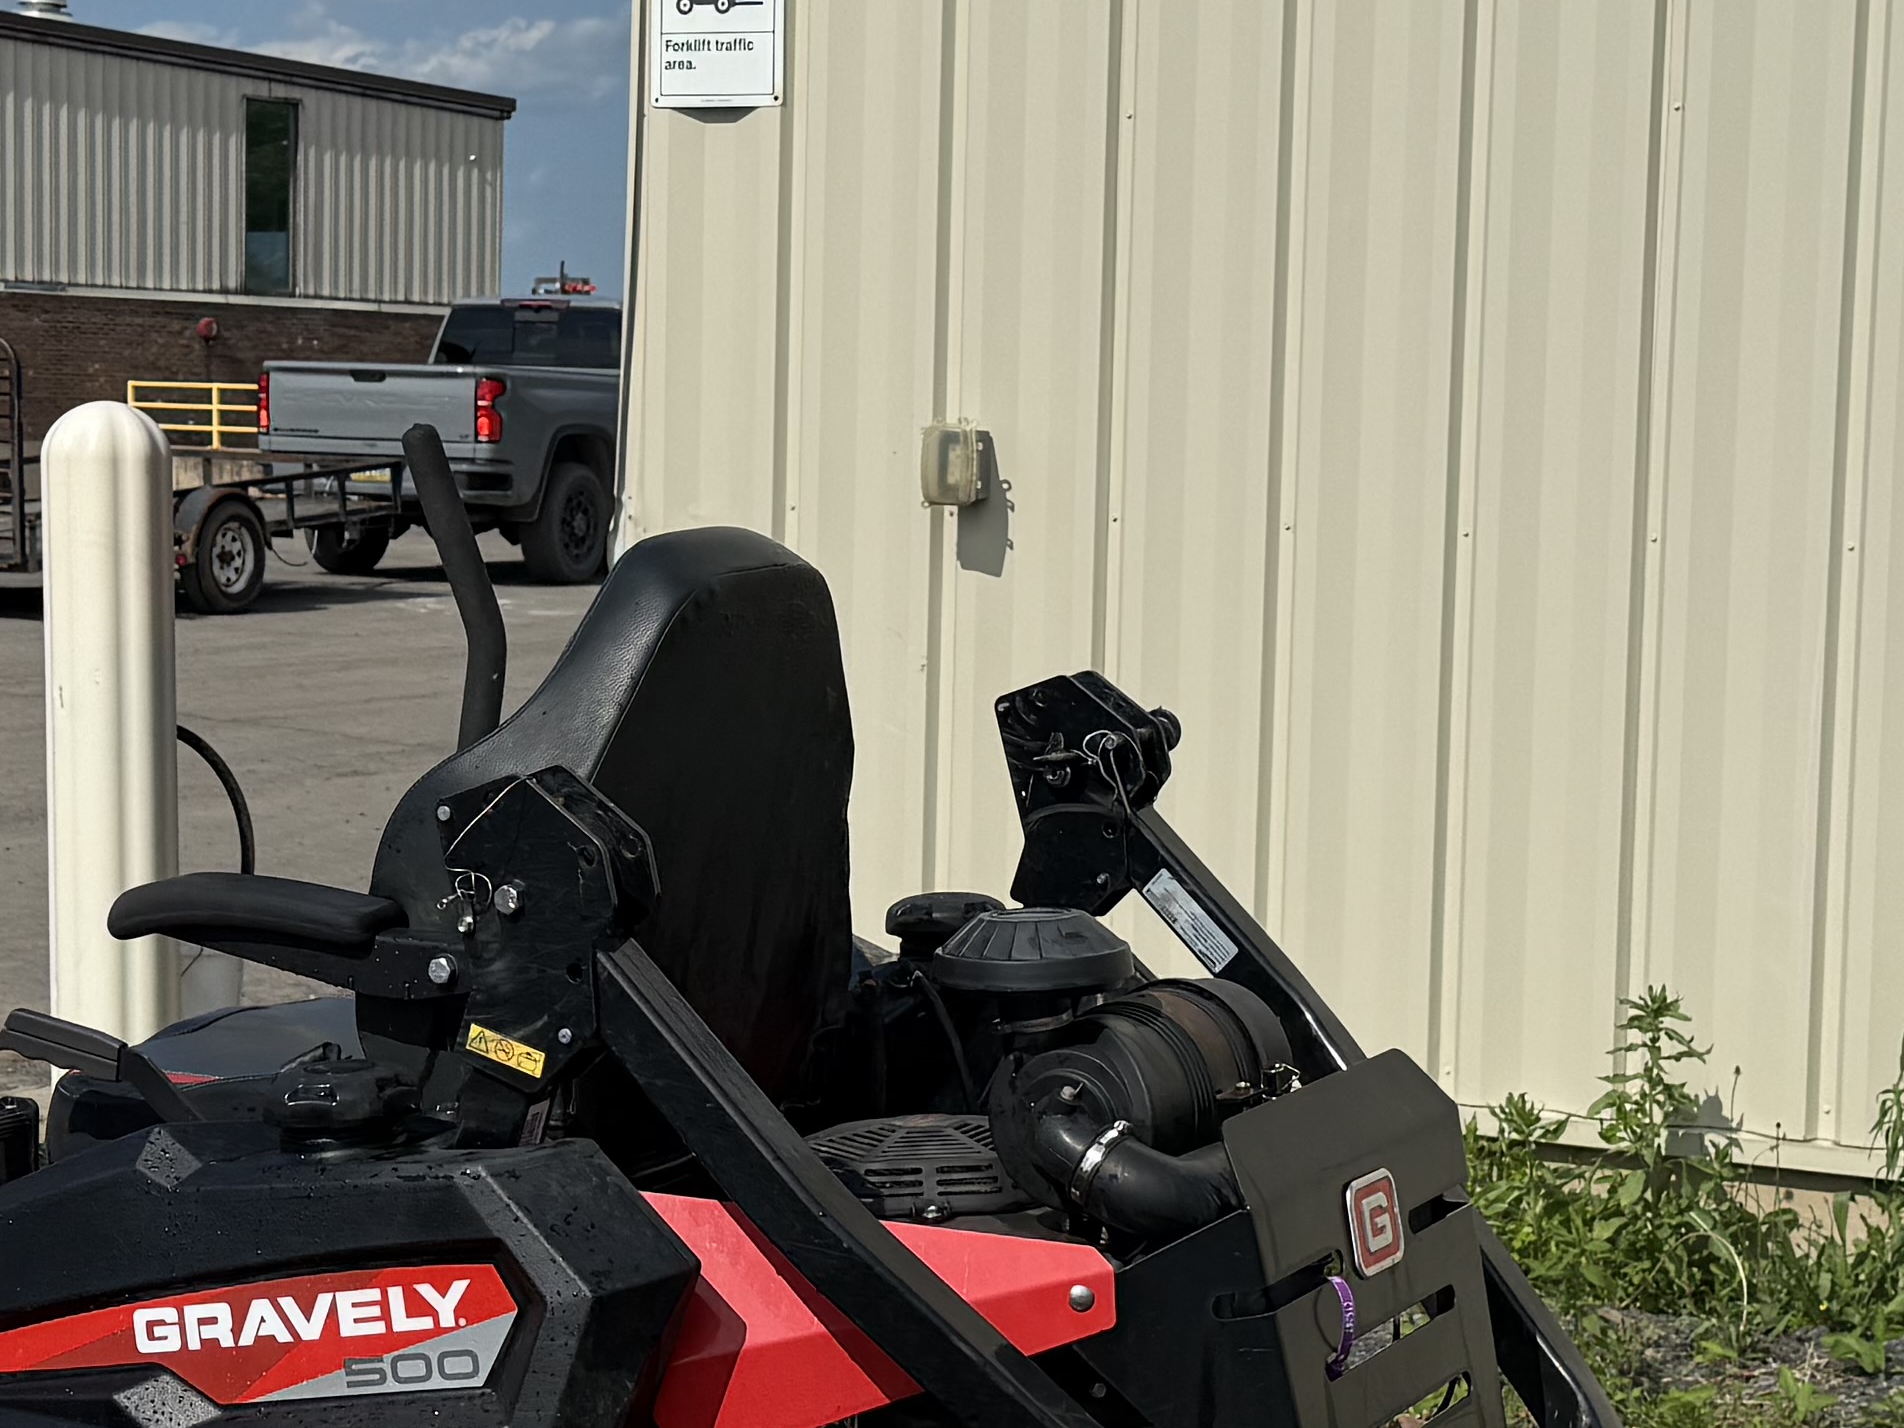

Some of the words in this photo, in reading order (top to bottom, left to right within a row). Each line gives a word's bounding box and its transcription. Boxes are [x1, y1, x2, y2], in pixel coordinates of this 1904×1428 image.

[664, 37, 712, 53] Forklift
[714, 37, 755, 52] traffic
[664, 59, 697, 71] area.
[132, 1278, 472, 1355] GRAVELY
[343, 1348, 480, 1389] 500
